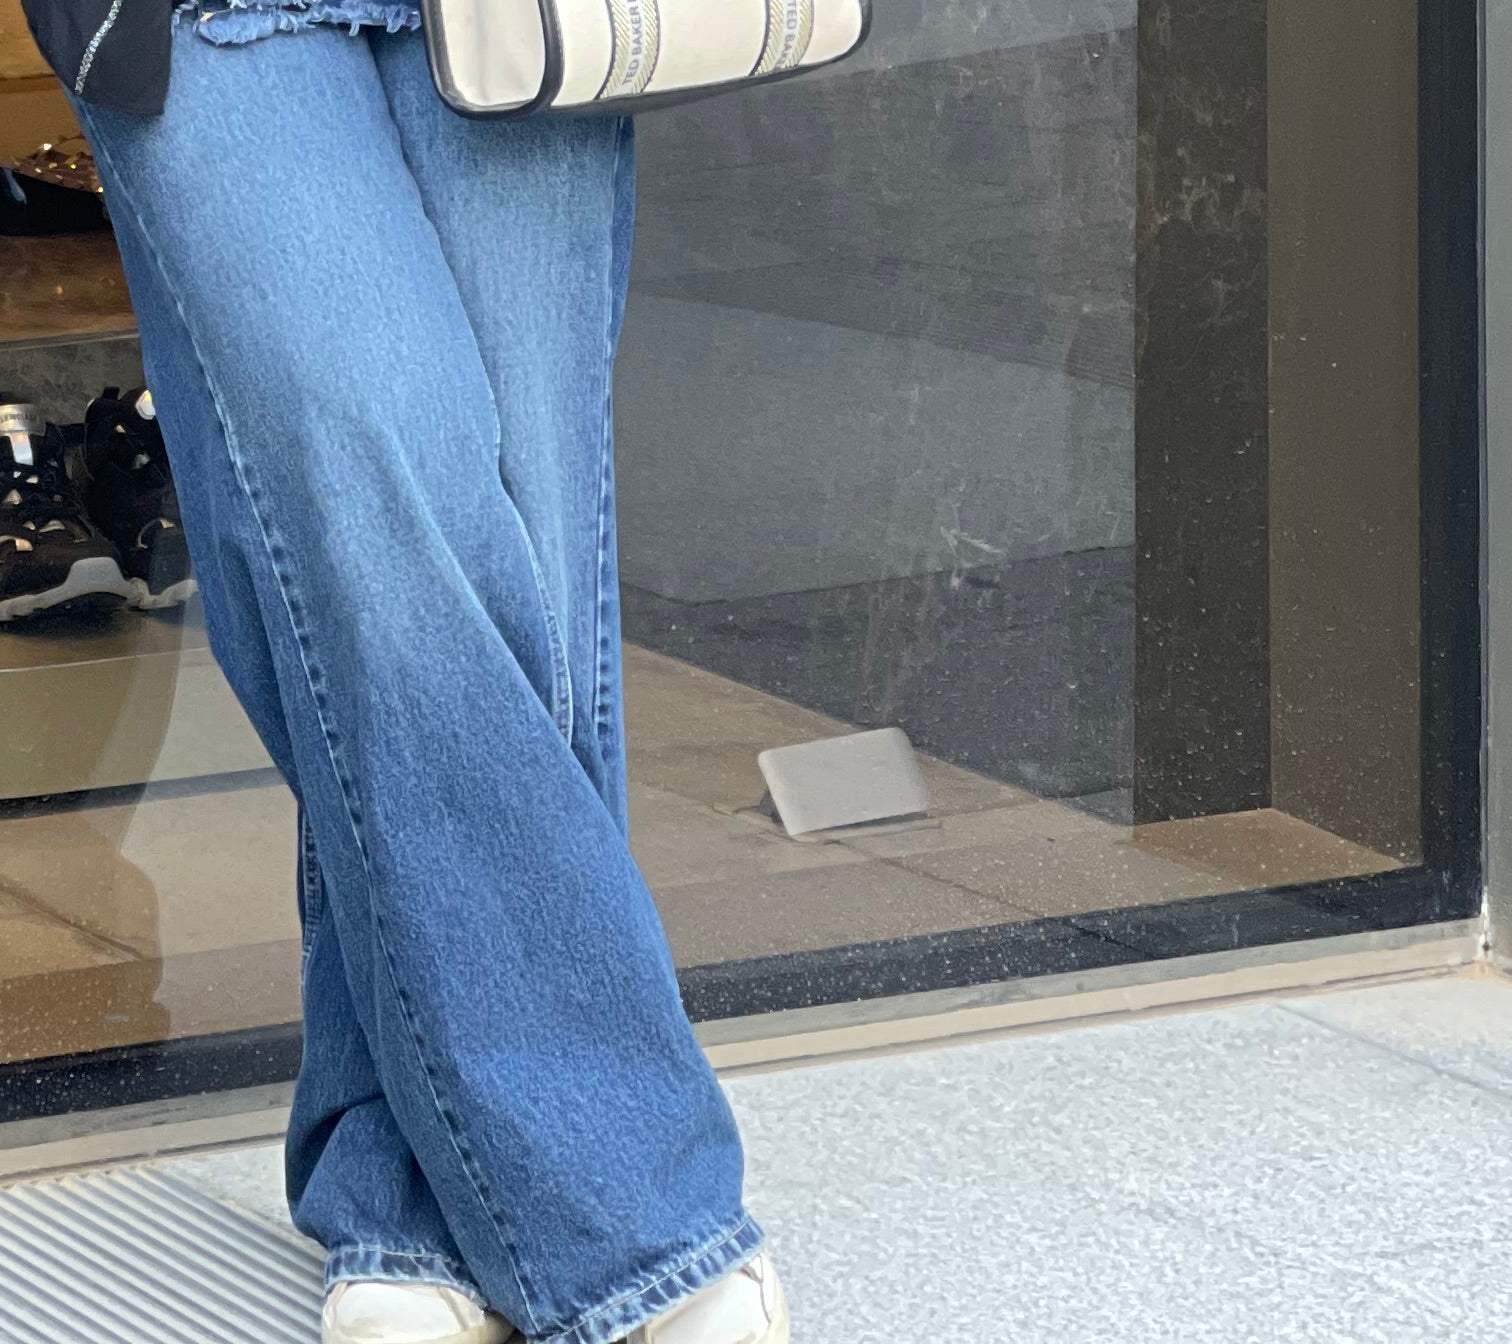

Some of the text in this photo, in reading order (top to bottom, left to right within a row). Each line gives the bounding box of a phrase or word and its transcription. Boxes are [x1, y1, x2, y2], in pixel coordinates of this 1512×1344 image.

[628, 6, 642, 56] BAKER
[775, 0, 798, 69] TED BAKE
[622, 57, 640, 86] TED
